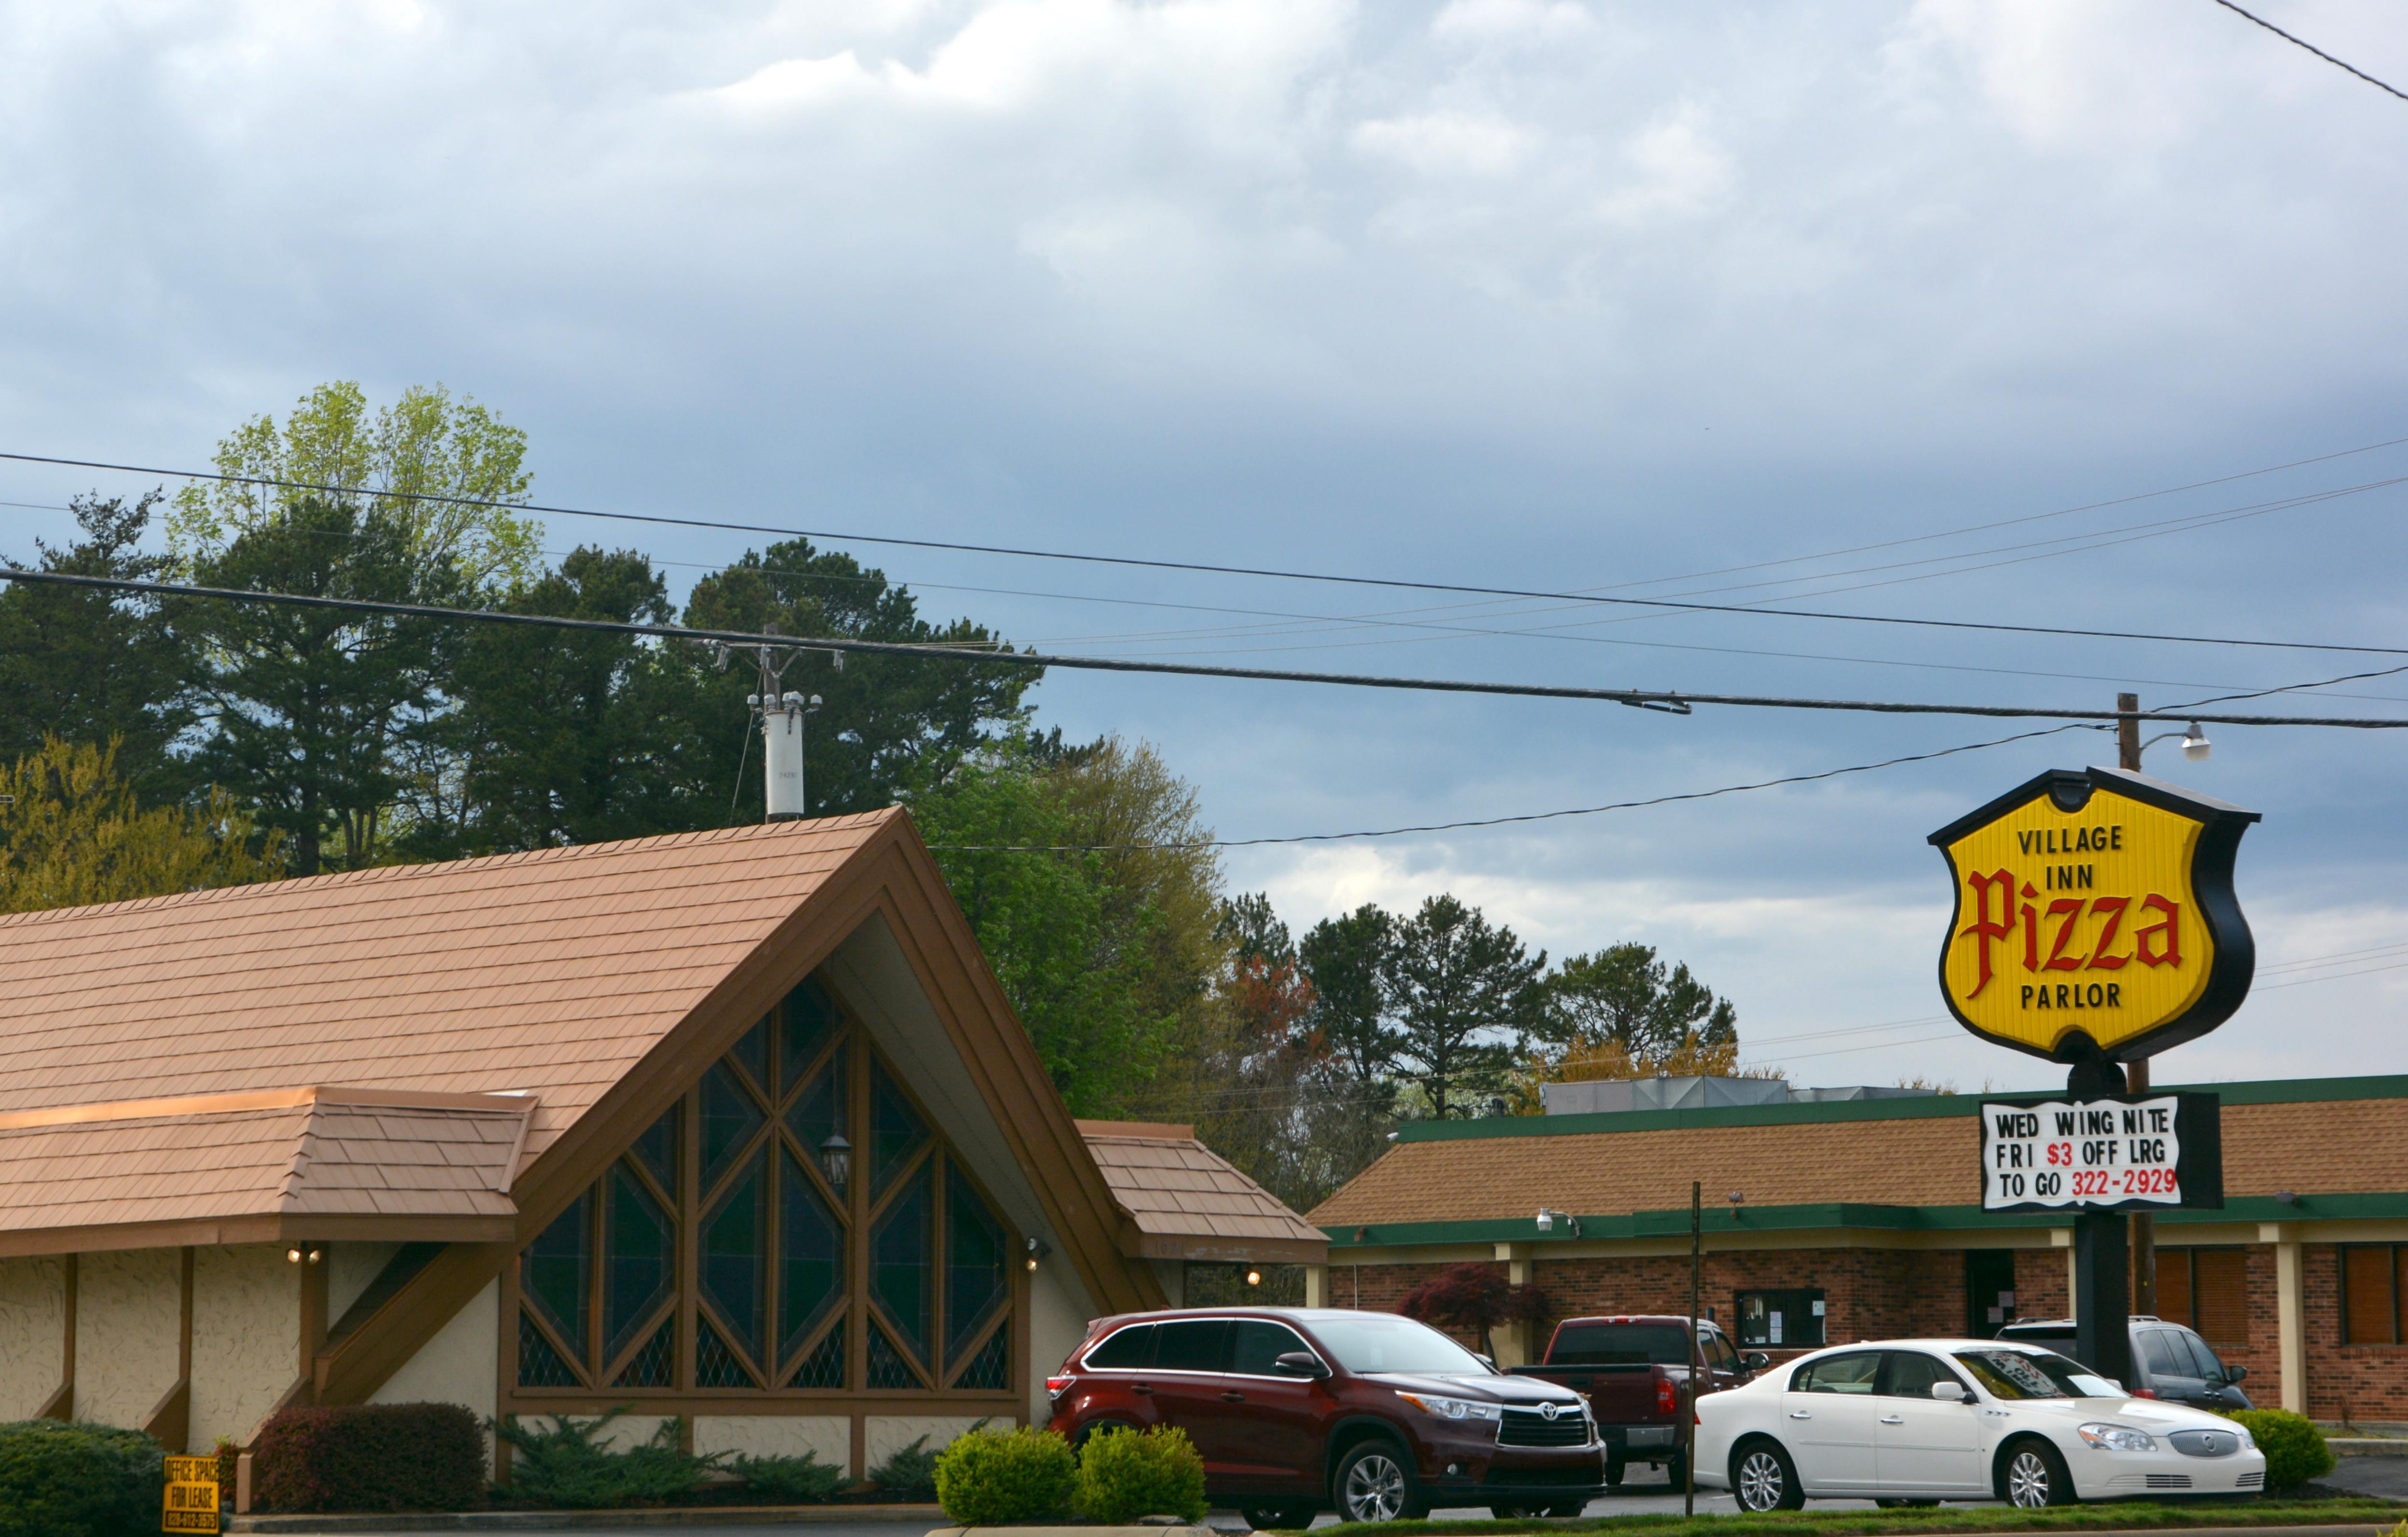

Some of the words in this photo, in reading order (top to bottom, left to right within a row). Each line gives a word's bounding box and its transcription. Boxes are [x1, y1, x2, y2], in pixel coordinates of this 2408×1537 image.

[2018, 825, 2121, 855] VILLAGE
[2046, 864, 2093, 890] INN
[1959, 868, 2182, 999] Pizza
[2021, 983, 2120, 1009] PARLOR
[1996, 1113, 2039, 1138] WED
[2055, 1110, 2114, 1136] WING
[2123, 1109, 2168, 1134] NITE
[1997, 1144, 2032, 1168] FRI
[2047, 1142, 2072, 1166] $3
[2083, 1140, 2118, 1165] OFF
[2130, 1139, 2165, 1163] LRG
[1999, 1173, 2025, 1197] TO
[2035, 1172, 2061, 1196] GO
[2072, 1168, 2176, 1196] 322-2929
[166, 1459, 192, 1482] OFFICE
[194, 1460, 219, 1483] SPACE
[171, 1486, 187, 1508] FOR
[188, 1487, 213, 1509] LEASE
